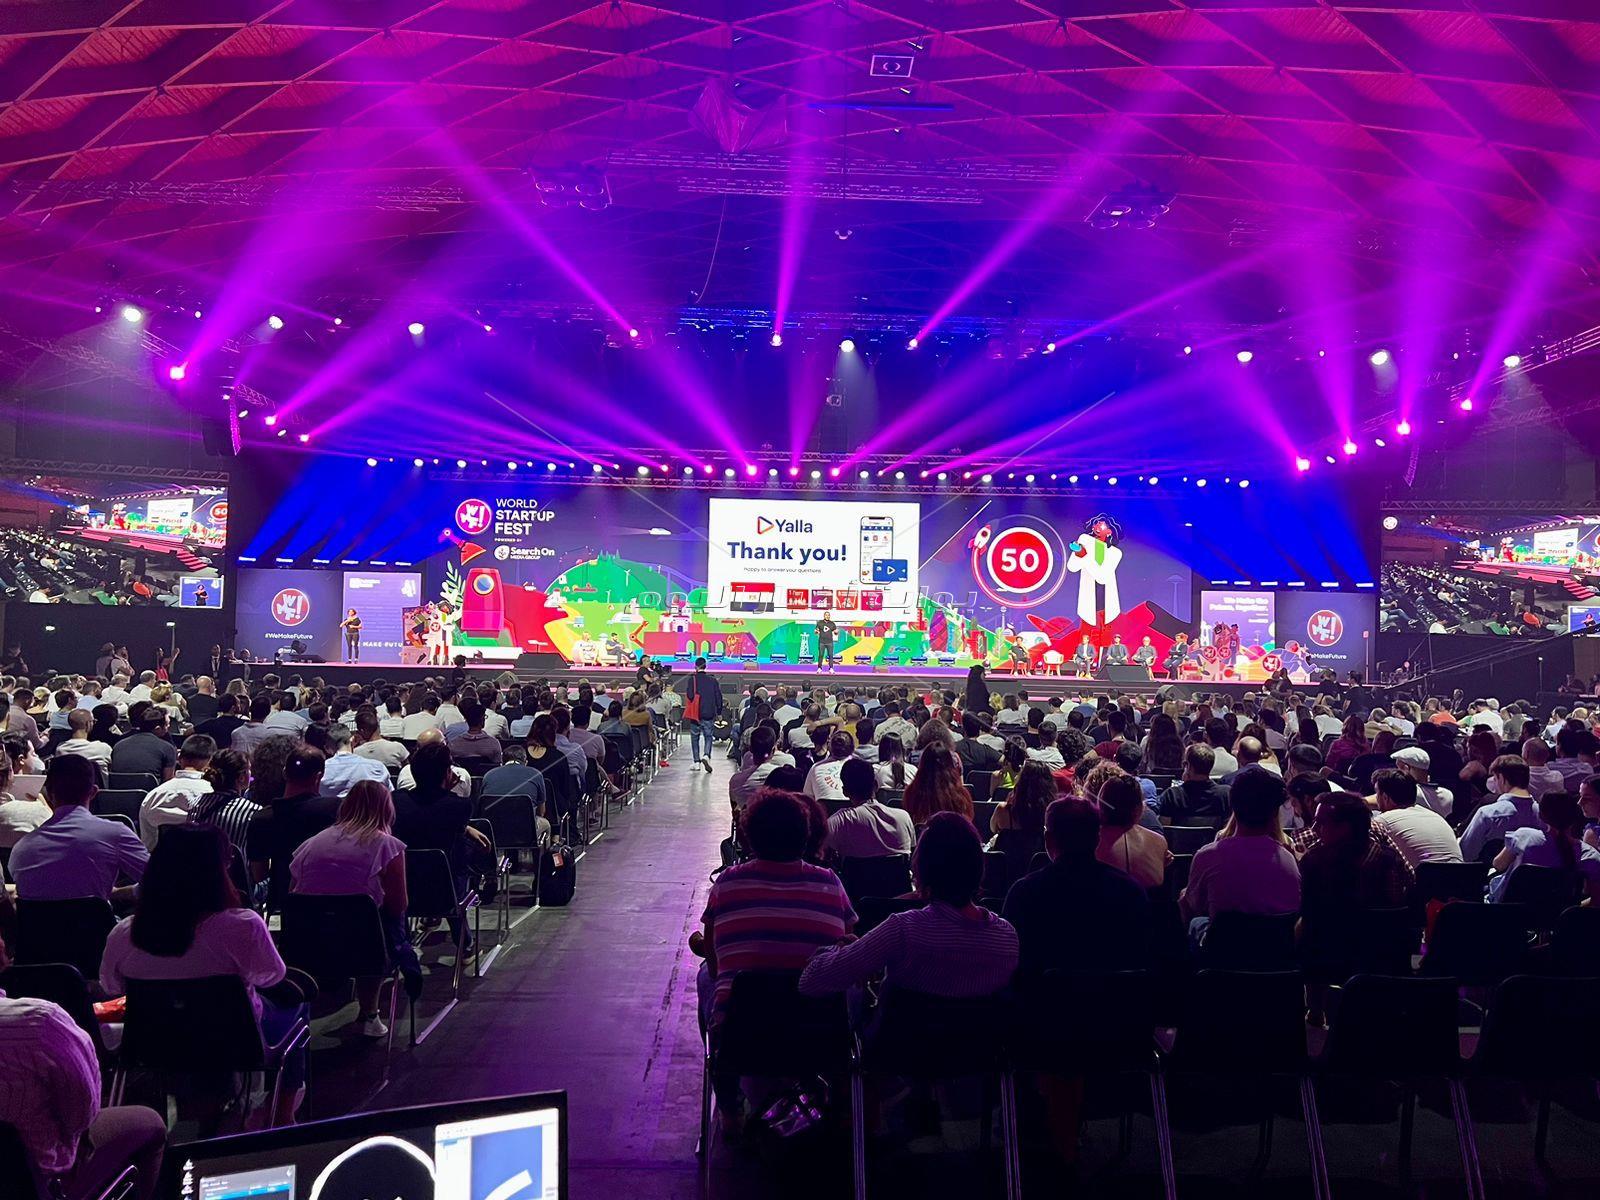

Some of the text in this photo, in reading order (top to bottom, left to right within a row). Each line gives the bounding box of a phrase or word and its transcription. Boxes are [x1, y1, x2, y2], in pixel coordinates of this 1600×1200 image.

[496, 498, 538, 509] WORLD
[496, 510, 555, 522] STARTUP
[495, 522, 532, 535] FEST
[775, 519, 813, 533] Yalla
[511, 547, 555, 556] Search On
[727, 541, 847, 566] Thank you!
[1001, 548, 1040, 573] 50
[264, 632, 314, 640] #WeMakeFuture
